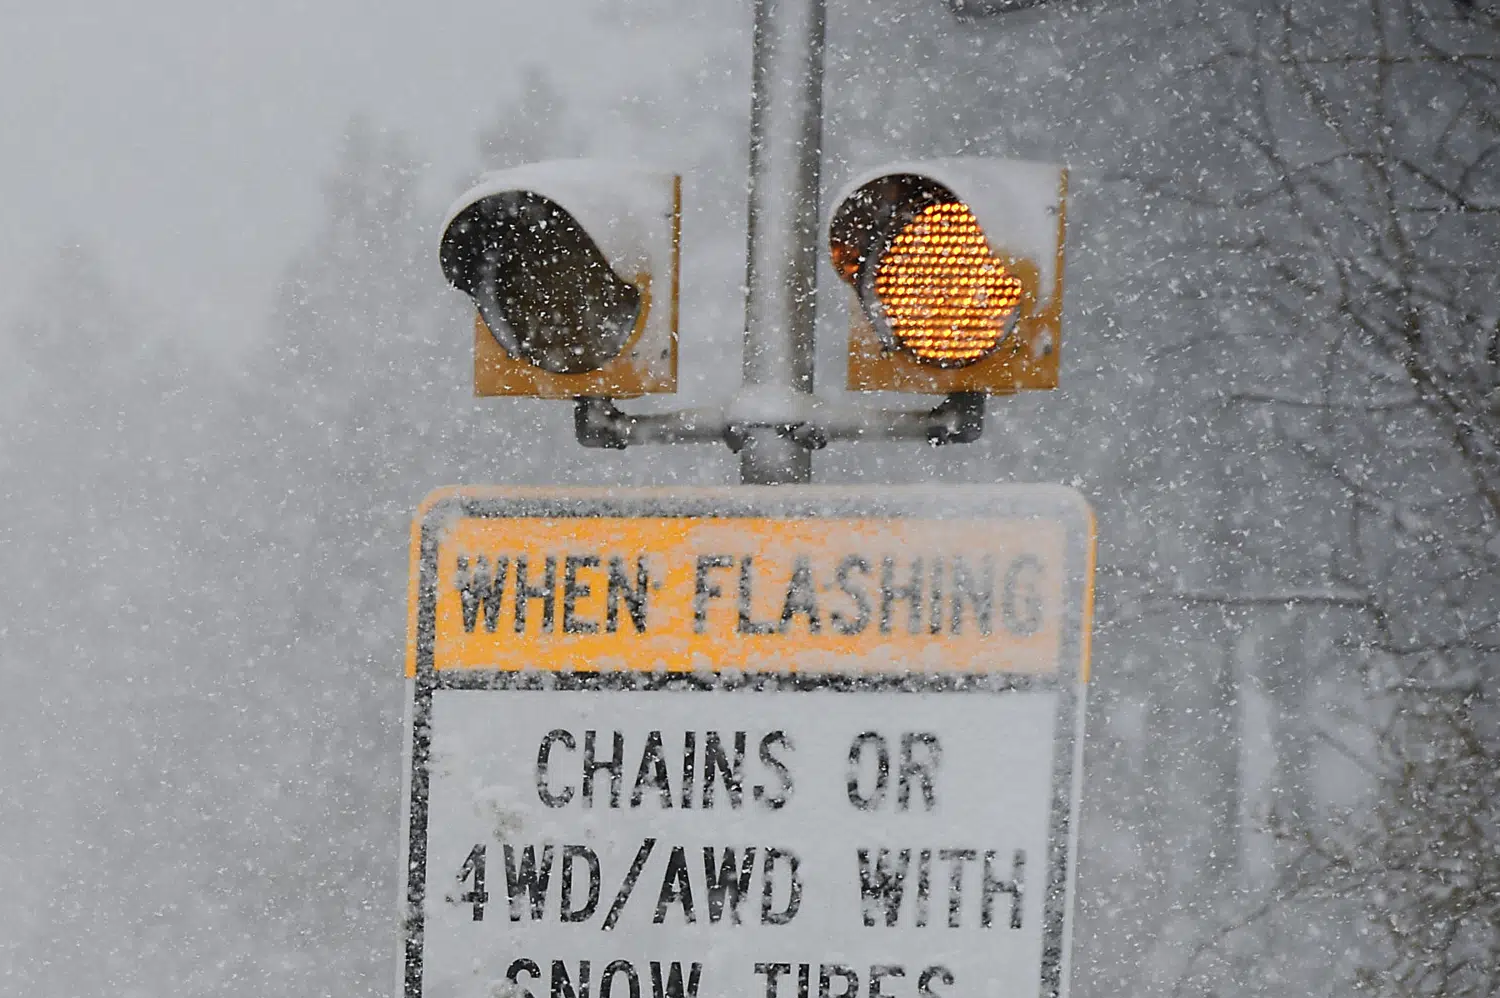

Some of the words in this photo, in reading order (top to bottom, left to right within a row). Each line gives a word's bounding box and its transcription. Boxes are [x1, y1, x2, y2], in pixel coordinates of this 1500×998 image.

[456, 555, 651, 634] WHEN
[694, 554, 1046, 637] FLASHING
[537, 729, 795, 810] CHAINS
[846, 731, 943, 812] OR
[445, 838, 801, 931] 4WD/AWD
[856, 848, 1026, 929] WITH
